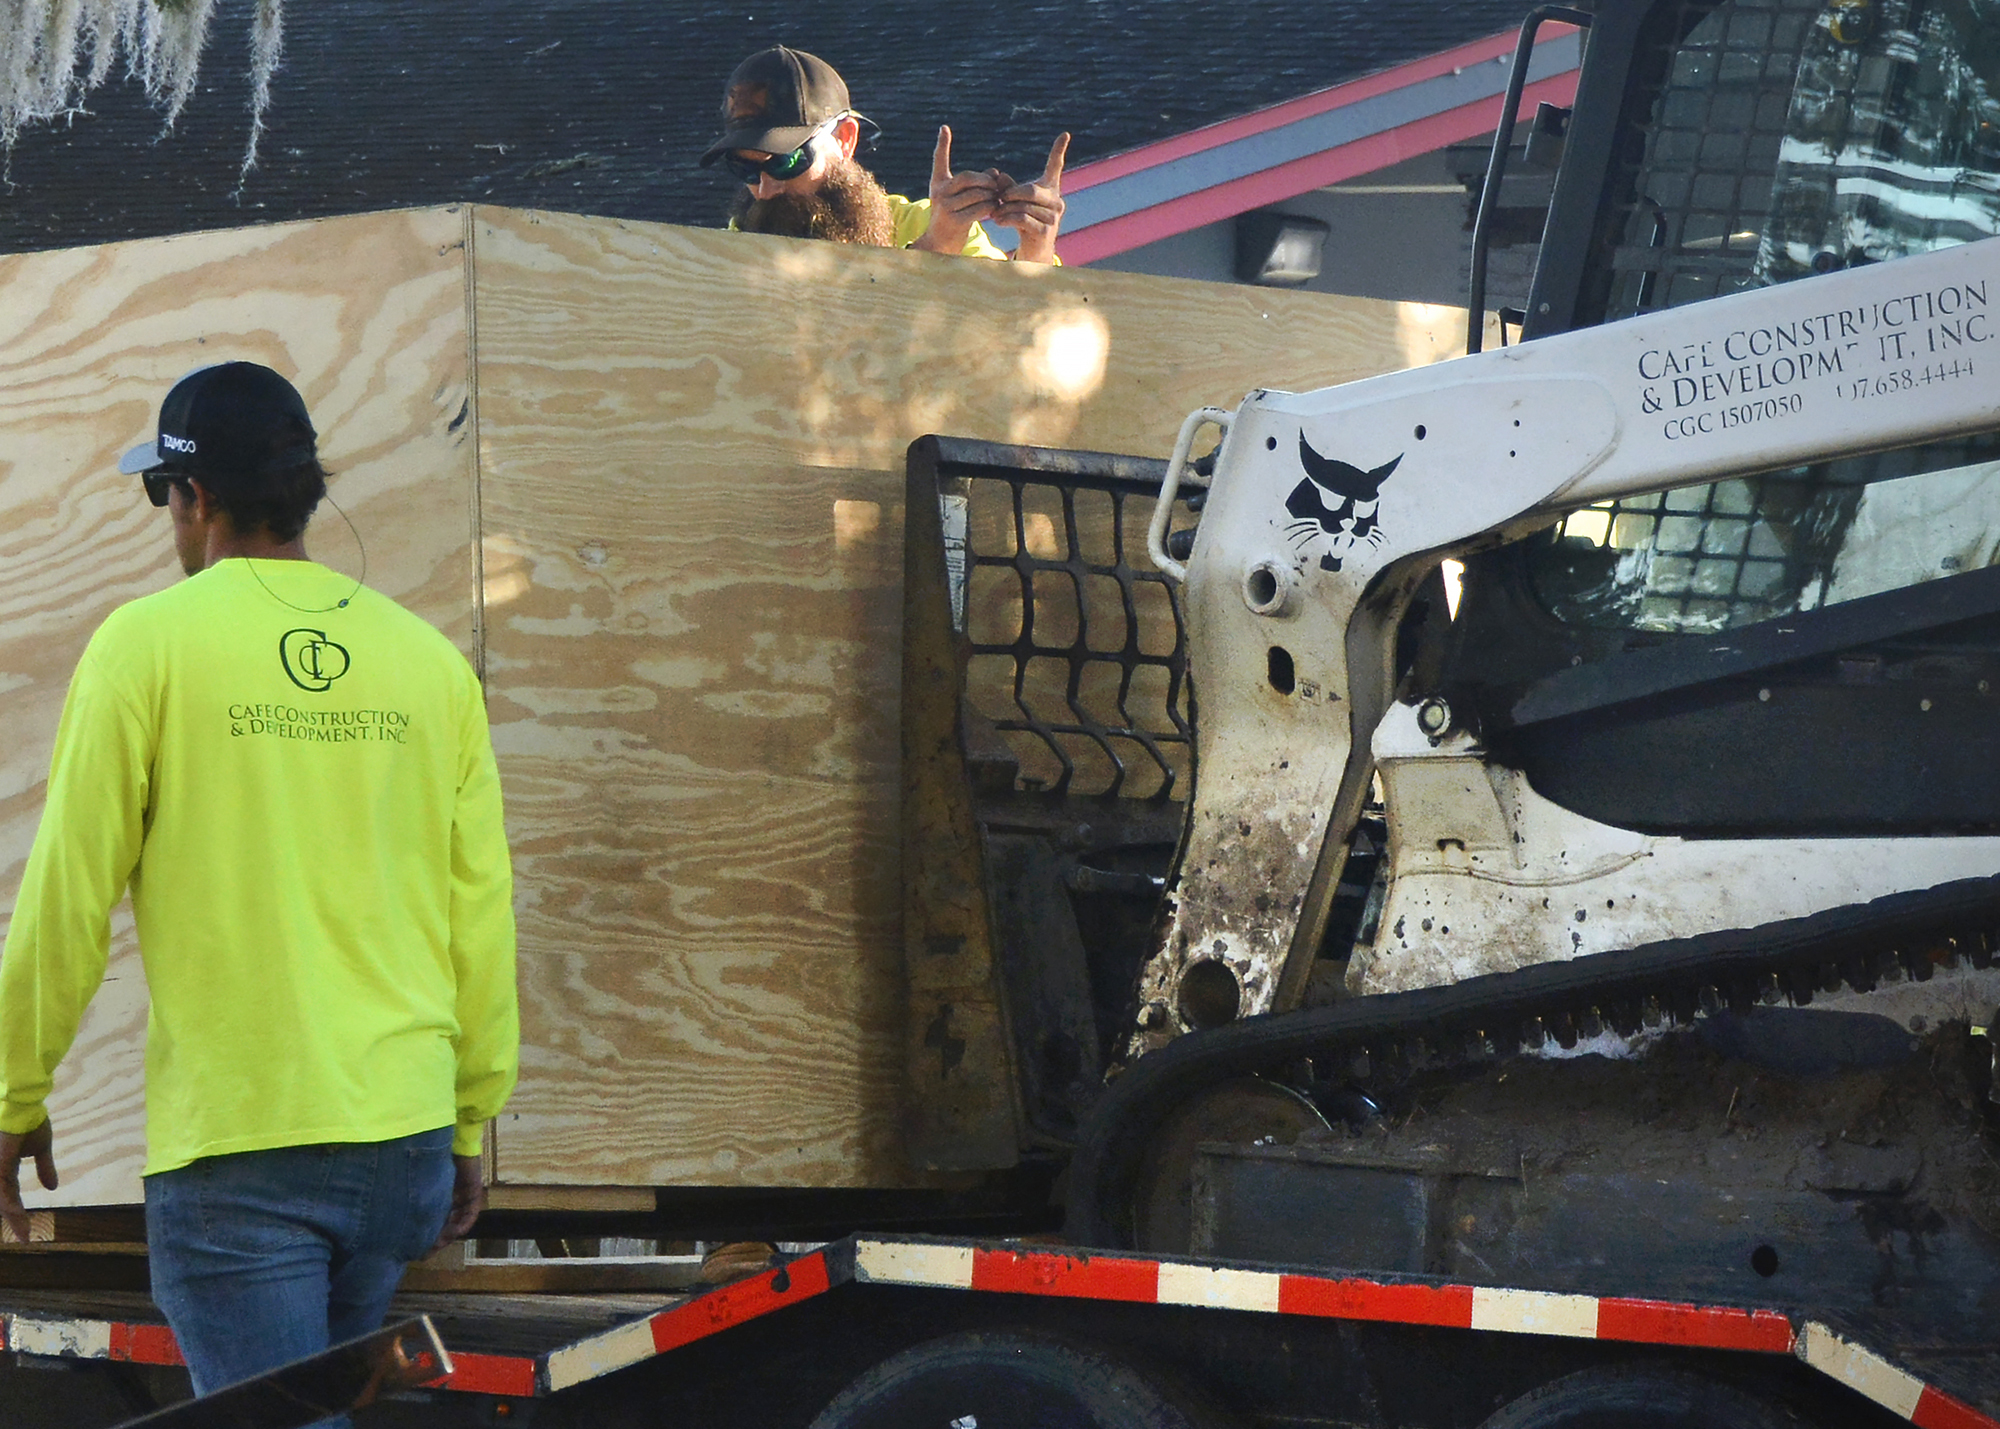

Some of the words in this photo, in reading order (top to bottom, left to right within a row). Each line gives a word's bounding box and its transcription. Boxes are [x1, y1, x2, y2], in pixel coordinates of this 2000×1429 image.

[1641, 387, 1663, 414] &
[1928, 315, 1995, 353] INC.
[1663, 412, 1713, 440] CGC
[1721, 393, 1803, 428] 1507050
[162, 434, 196, 453] TAMCO
[274, 705, 410, 727] CONSTRUCTION
[230, 722, 245, 737] &
